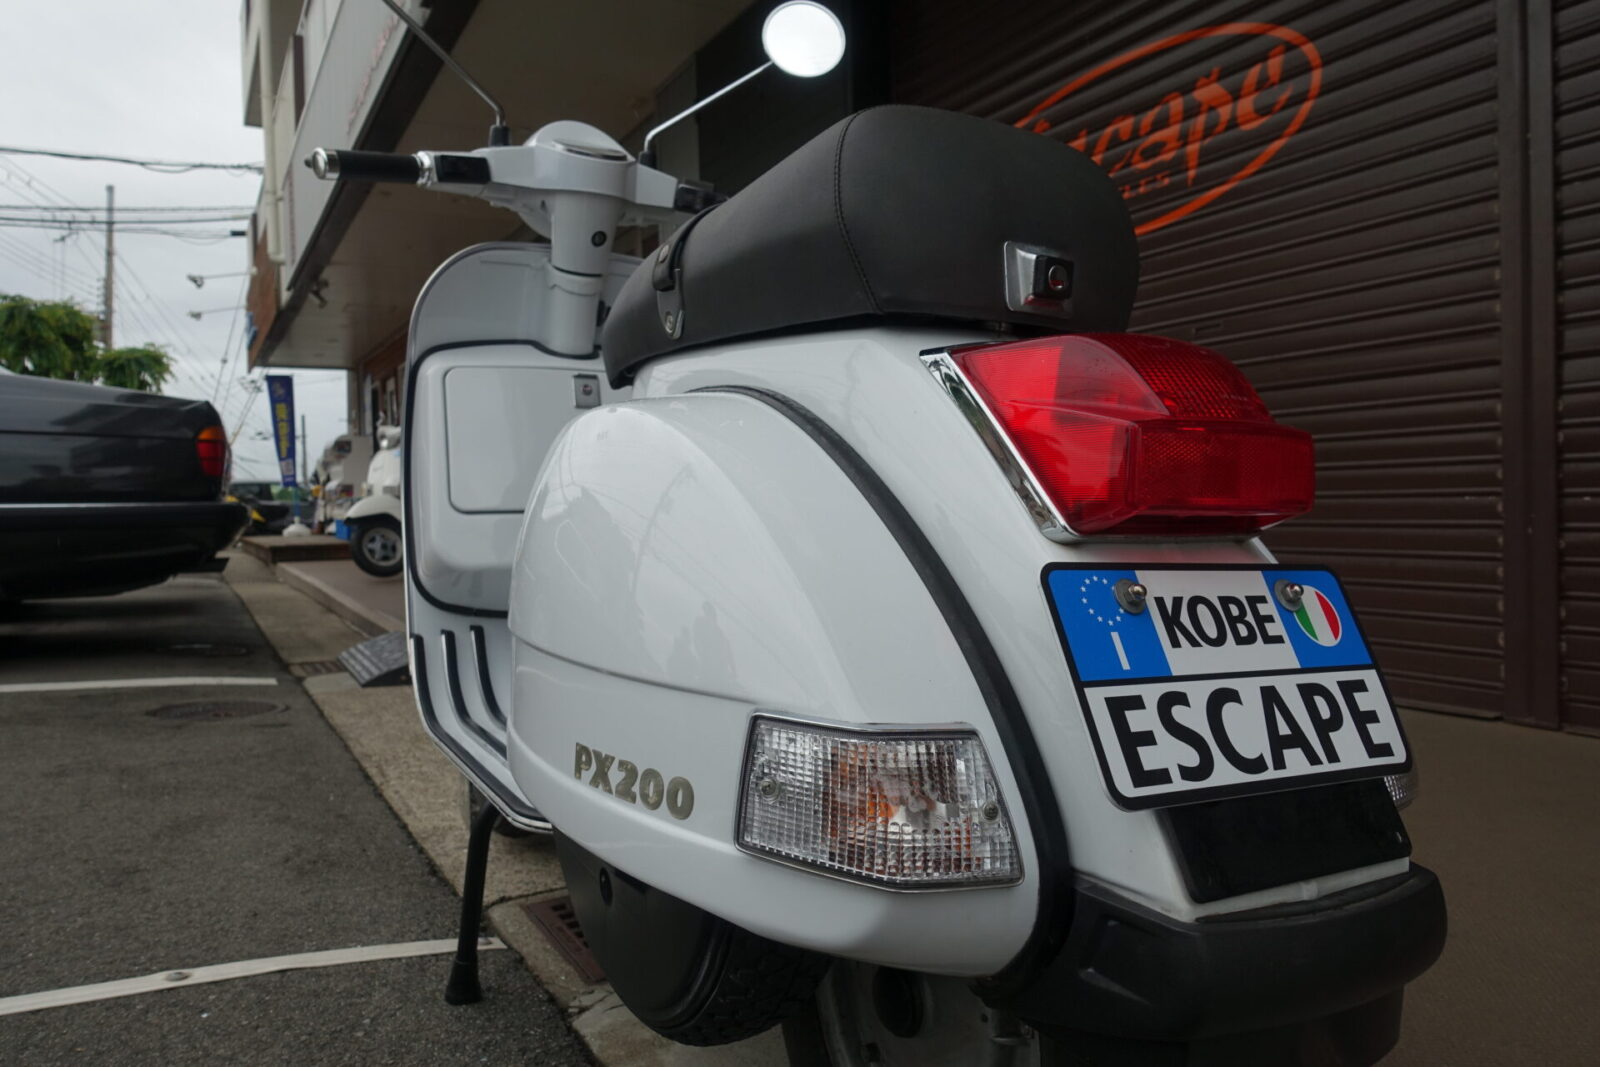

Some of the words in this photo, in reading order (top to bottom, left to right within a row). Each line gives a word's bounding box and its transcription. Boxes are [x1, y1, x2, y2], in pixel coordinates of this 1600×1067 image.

[1153, 594, 1285, 649] KOBE
[1104, 679, 1395, 788] ESCAPE
[574, 742, 695, 820] PX200
